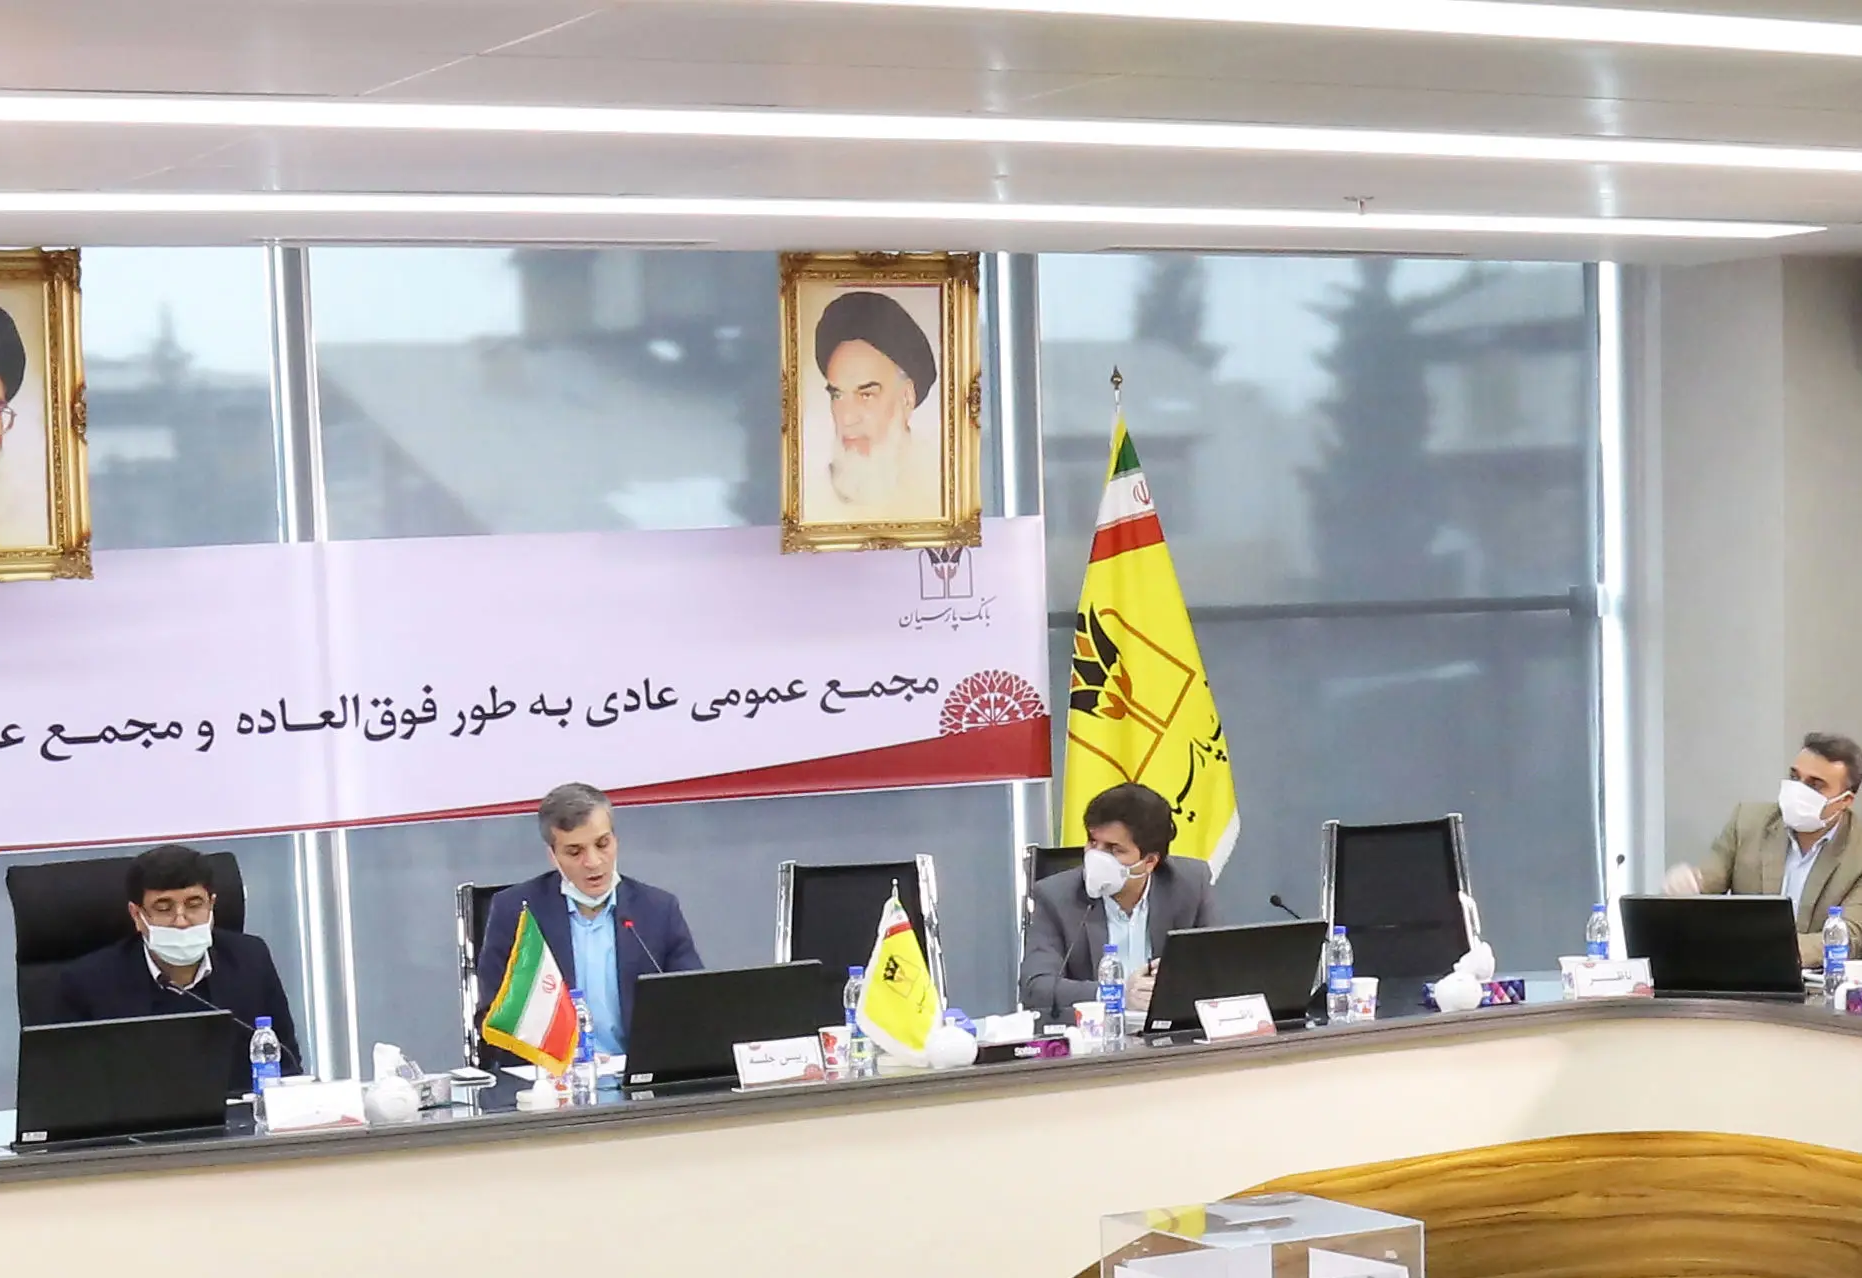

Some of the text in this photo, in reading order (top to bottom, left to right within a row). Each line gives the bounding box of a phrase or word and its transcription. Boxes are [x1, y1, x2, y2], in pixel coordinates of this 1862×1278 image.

[898, 595, 997, 631] بانک پارسیان
[449, 685, 517, 737] طور
[528, 692, 573, 729] به
[586, 677, 679, 728] عادی
[691, 679, 808, 722] عمومی
[820, 673, 940, 715] مجمع
[39, 718, 183, 762] مجمع
[194, 719, 216, 752] و
